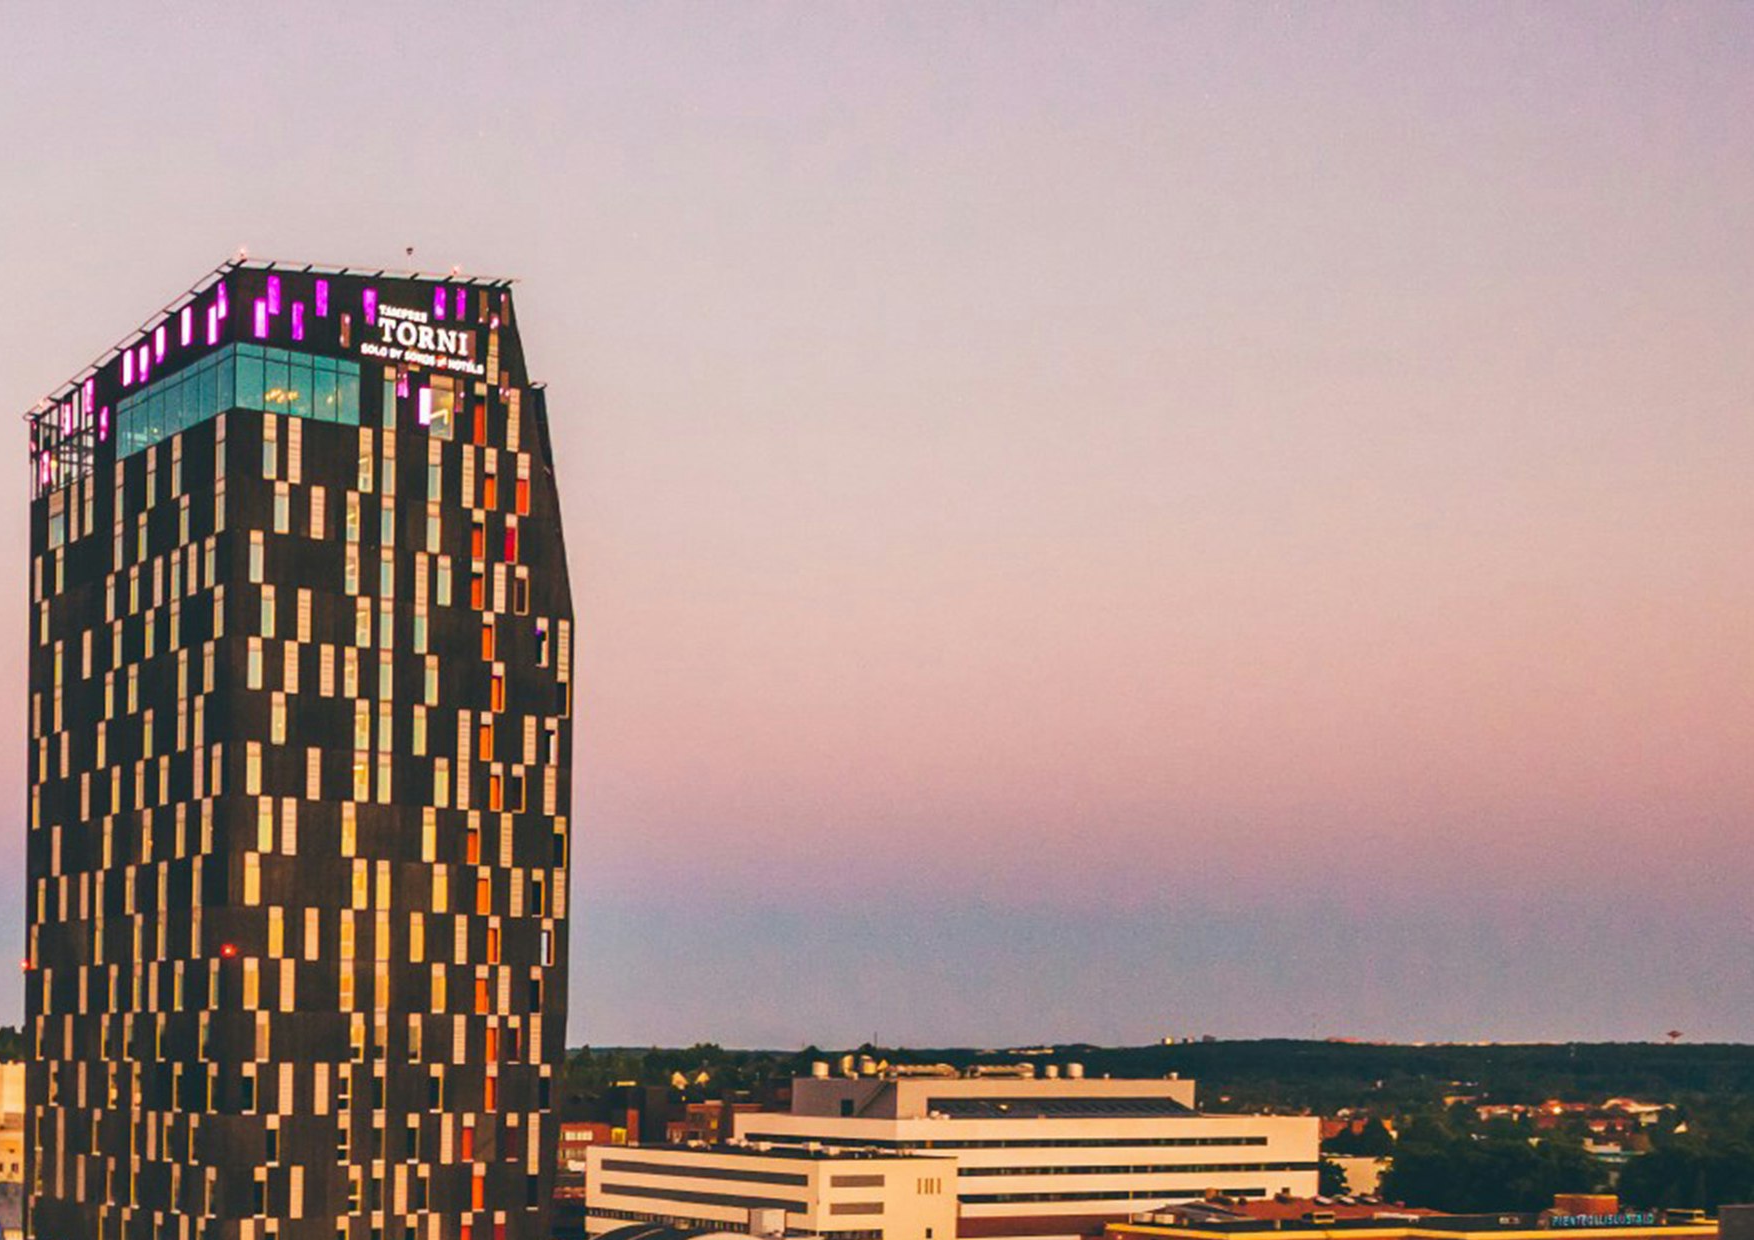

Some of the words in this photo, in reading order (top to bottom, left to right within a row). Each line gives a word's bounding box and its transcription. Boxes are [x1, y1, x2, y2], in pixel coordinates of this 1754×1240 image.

[378, 317, 469, 357] TORNI
[360, 342, 388, 358] SOLO
[389, 347, 403, 360] BY
[404, 350, 436, 367] SOKOS
[448, 358, 485, 376] HOTELS
